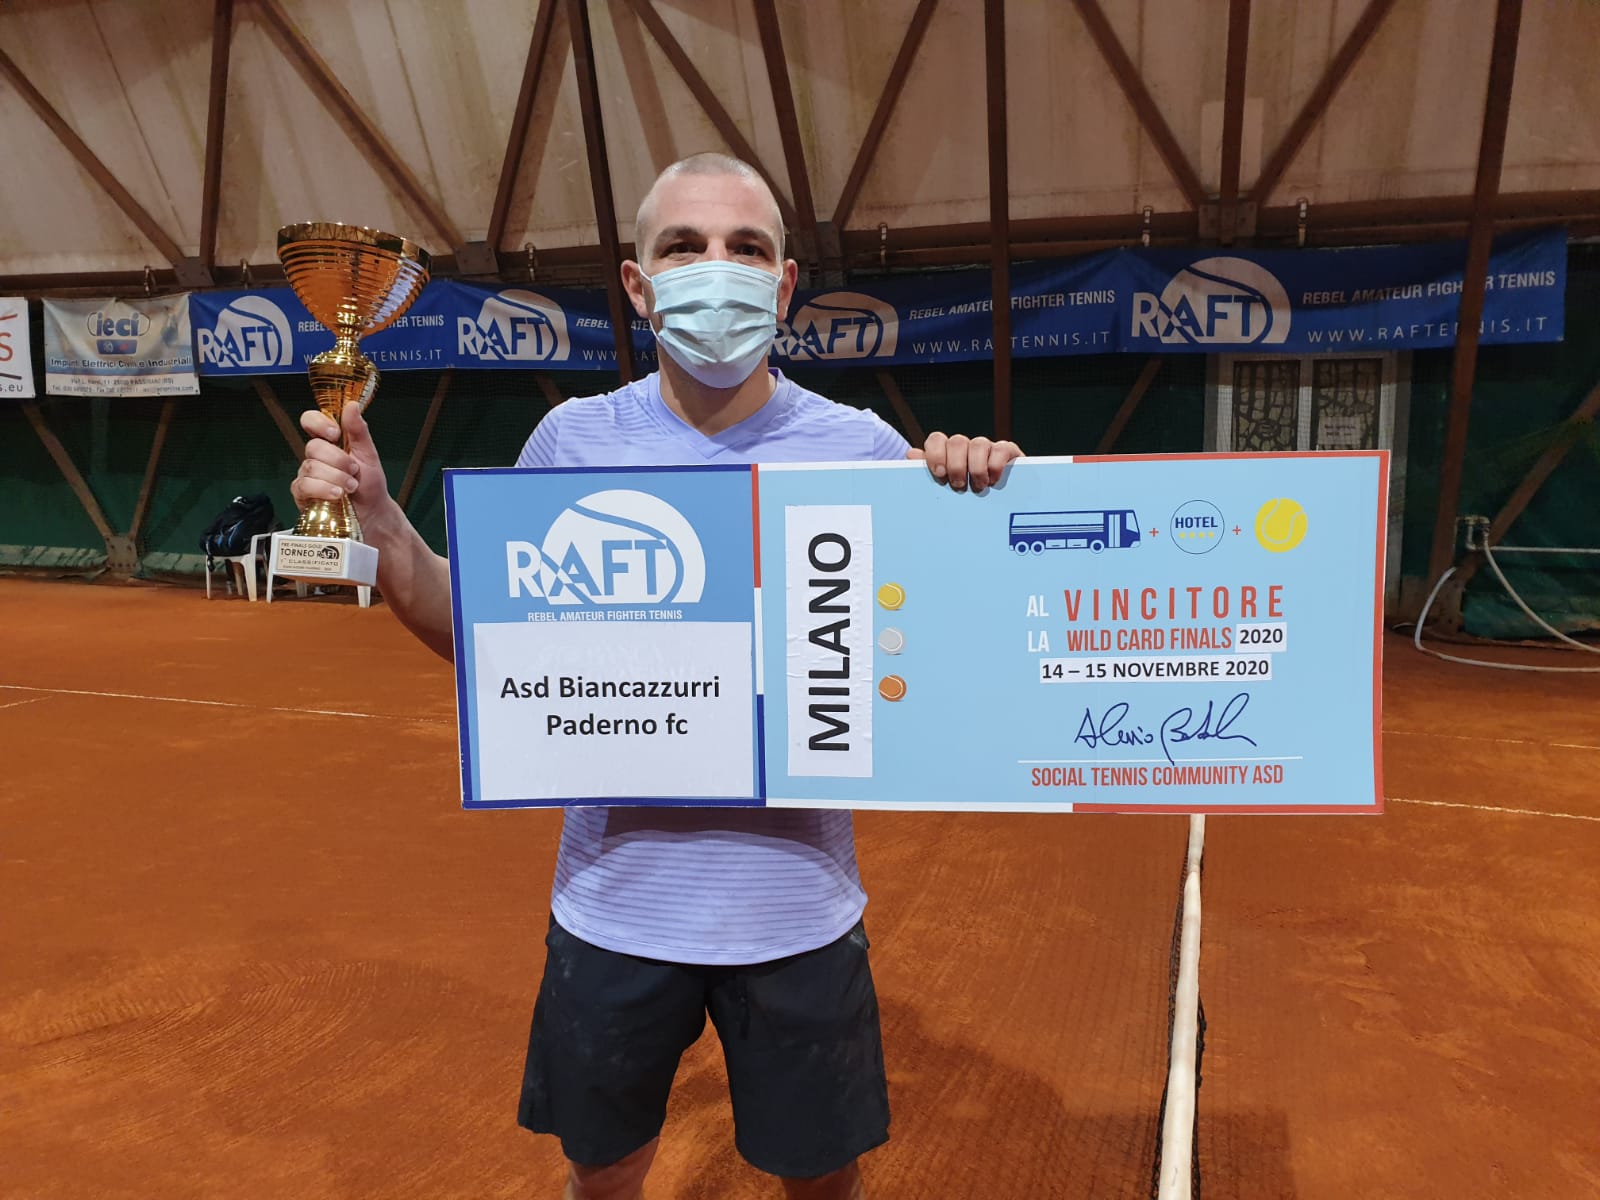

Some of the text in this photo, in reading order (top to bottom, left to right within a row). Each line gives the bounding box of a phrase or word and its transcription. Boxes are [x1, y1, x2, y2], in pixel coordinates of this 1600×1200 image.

[1302, 270, 1556, 305] REBEL AMATEUR FIGHR TENNIS
[909, 289, 1115, 320] REBEL AMATE FIGHTER TENNIS
[410, 315, 445, 329] TENNIS
[576, 318, 609, 329] REBEL
[1308, 316, 1548, 343] WWW.RAFTEIS.IT
[912, 331, 1112, 354] WWW.RATENNIS.IT
[1174, 516, 1219, 529] HOTEL
[281, 548, 315, 557] TORNEO
[1026, 585, 1284, 621] AL VINCITORE
[528, 610, 682, 622] REBEL AMATEUR FIGHTER TENNIS
[808, 532, 852, 751] MILANO
[1028, 627, 1283, 652] LA WILD CARD FINALS 2020
[1042, 664, 1064, 679] 14
[1086, 663, 1107, 678] 15
[1113, 661, 1220, 678] NOVEMBRE
[1225, 660, 1269, 676] 2020
[500, 676, 720, 699] Asd Biancazzurri
[546, 713, 688, 736] Paderno fc
[1031, 765, 1284, 786] SOCIAL TENNIS COMMUNITY ASD
